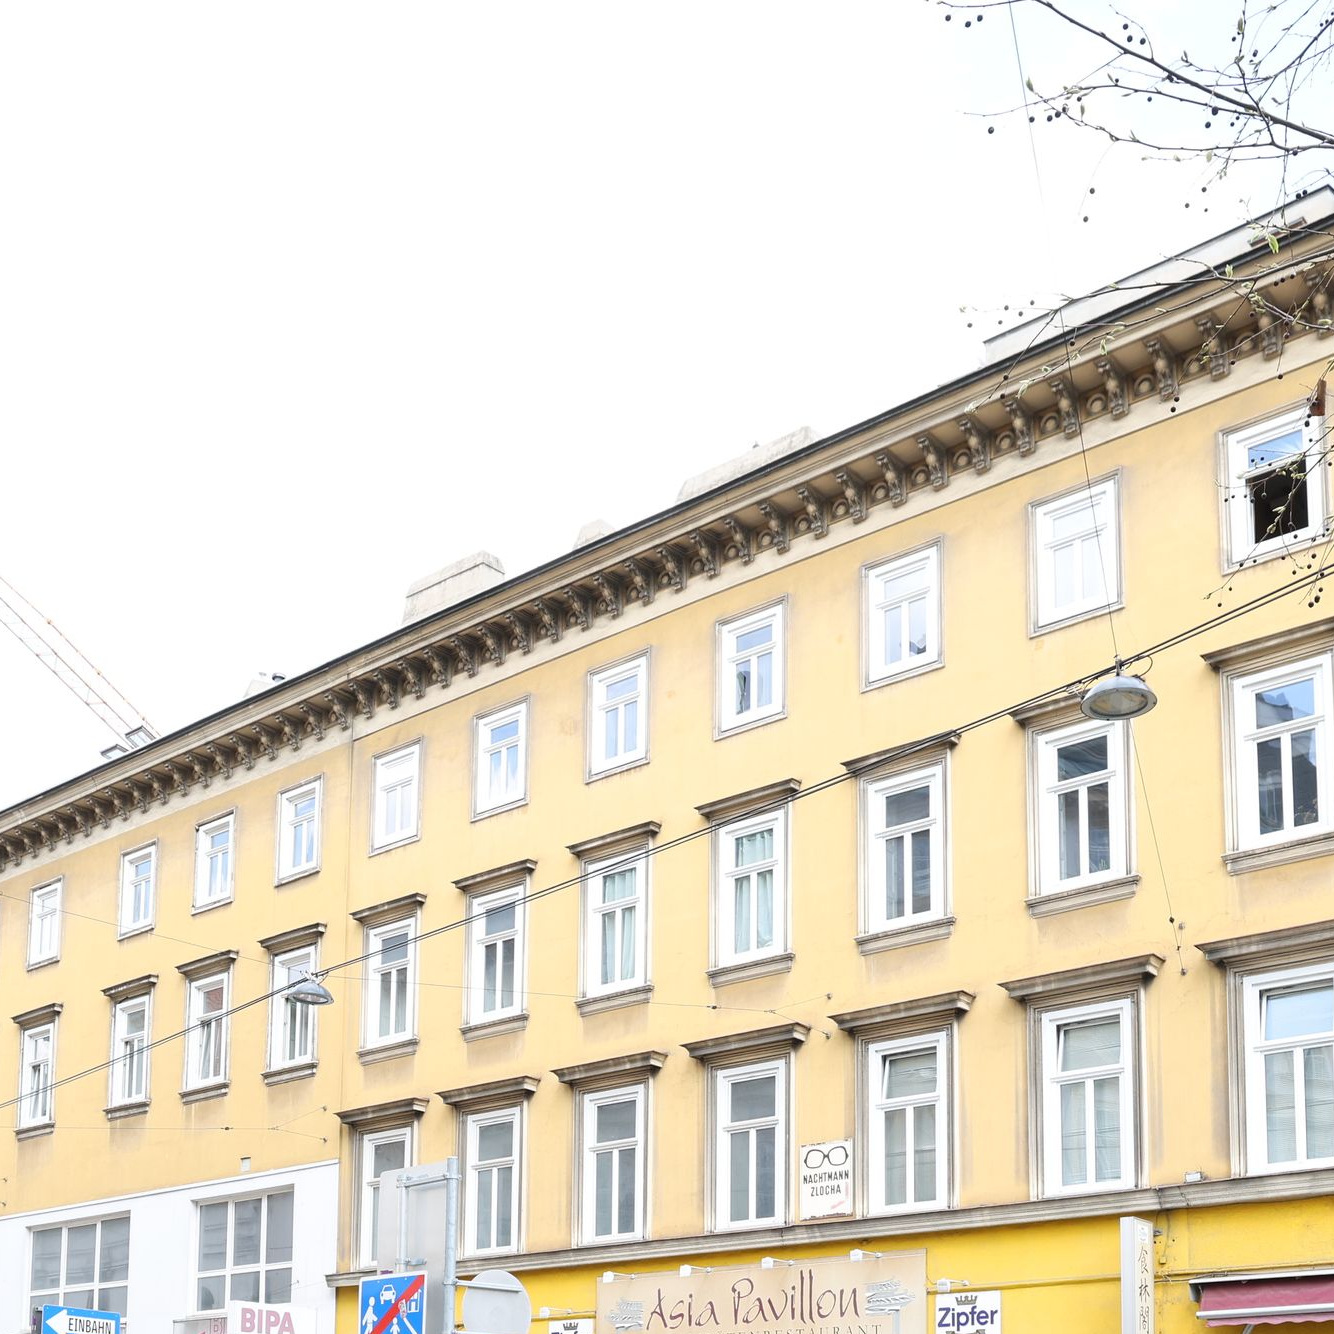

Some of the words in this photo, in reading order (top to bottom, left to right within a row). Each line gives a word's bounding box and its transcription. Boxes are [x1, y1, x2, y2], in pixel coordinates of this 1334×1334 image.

[803, 1170, 849, 1184] NACHTMANN
[811, 1184, 842, 1197] ZLOCHA
[646, 1288, 719, 1331] Asia
[731, 1269, 861, 1326] Pavillon
[68, 1317, 112, 1334] EINBAHN
[937, 1305, 999, 1332] Zipfer
